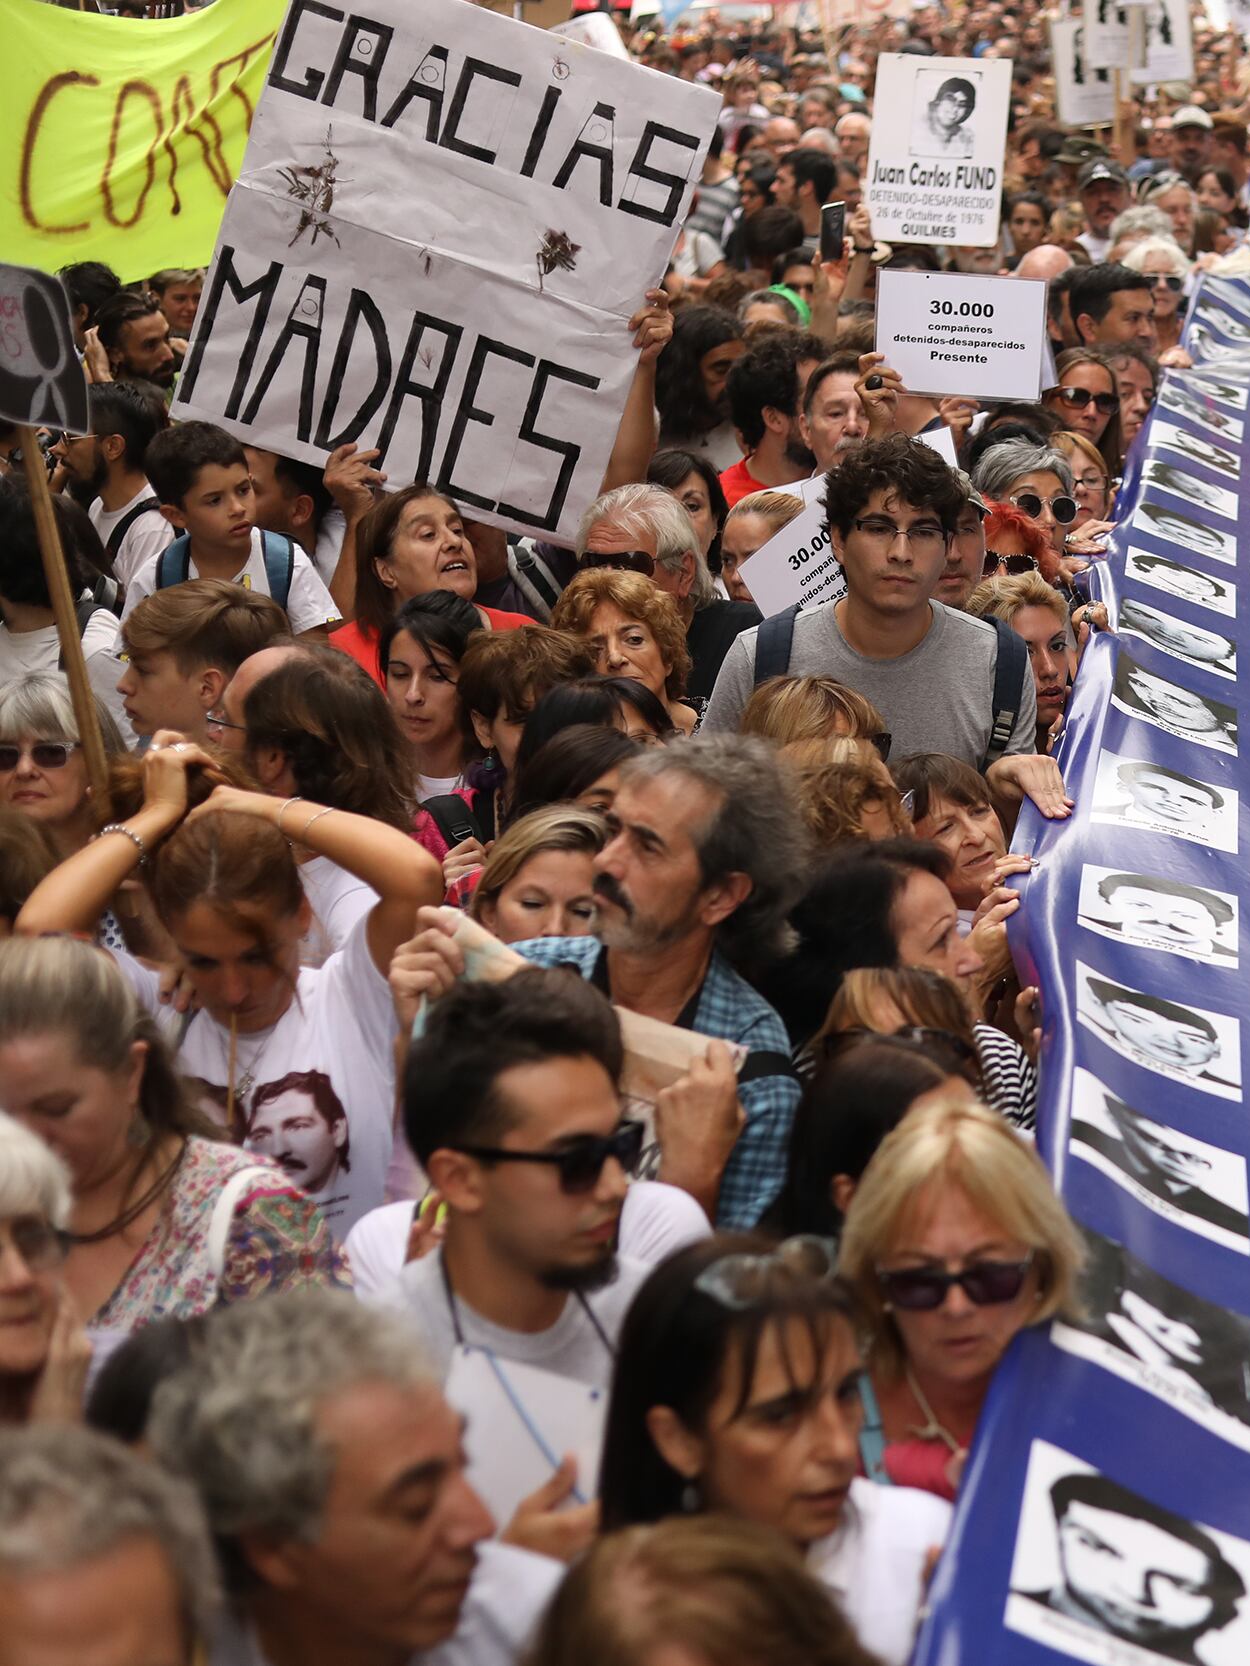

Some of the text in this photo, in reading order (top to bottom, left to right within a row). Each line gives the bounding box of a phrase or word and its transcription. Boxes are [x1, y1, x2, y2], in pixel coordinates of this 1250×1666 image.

[267, 0, 700, 227] GRACIAS
[872, 160, 996, 191] Juan Carlos FUND
[870, 189, 995, 210] DETENIDO-DESAPARECIDO
[891, 208, 903, 219] de
[905, 208, 942, 222] Octubre
[945, 211, 957, 223] de
[961, 212, 985, 225] 1976
[901, 223, 957, 238] QUILMES
[930, 300, 994, 318] 30.000
[928, 322, 993, 335] compañeros
[893, 334, 1026, 350] detenidos-desaparecidos
[930, 351, 988, 364] Presente
[178, 245, 601, 533] MADRES
[800, 555, 836, 587] compañ
